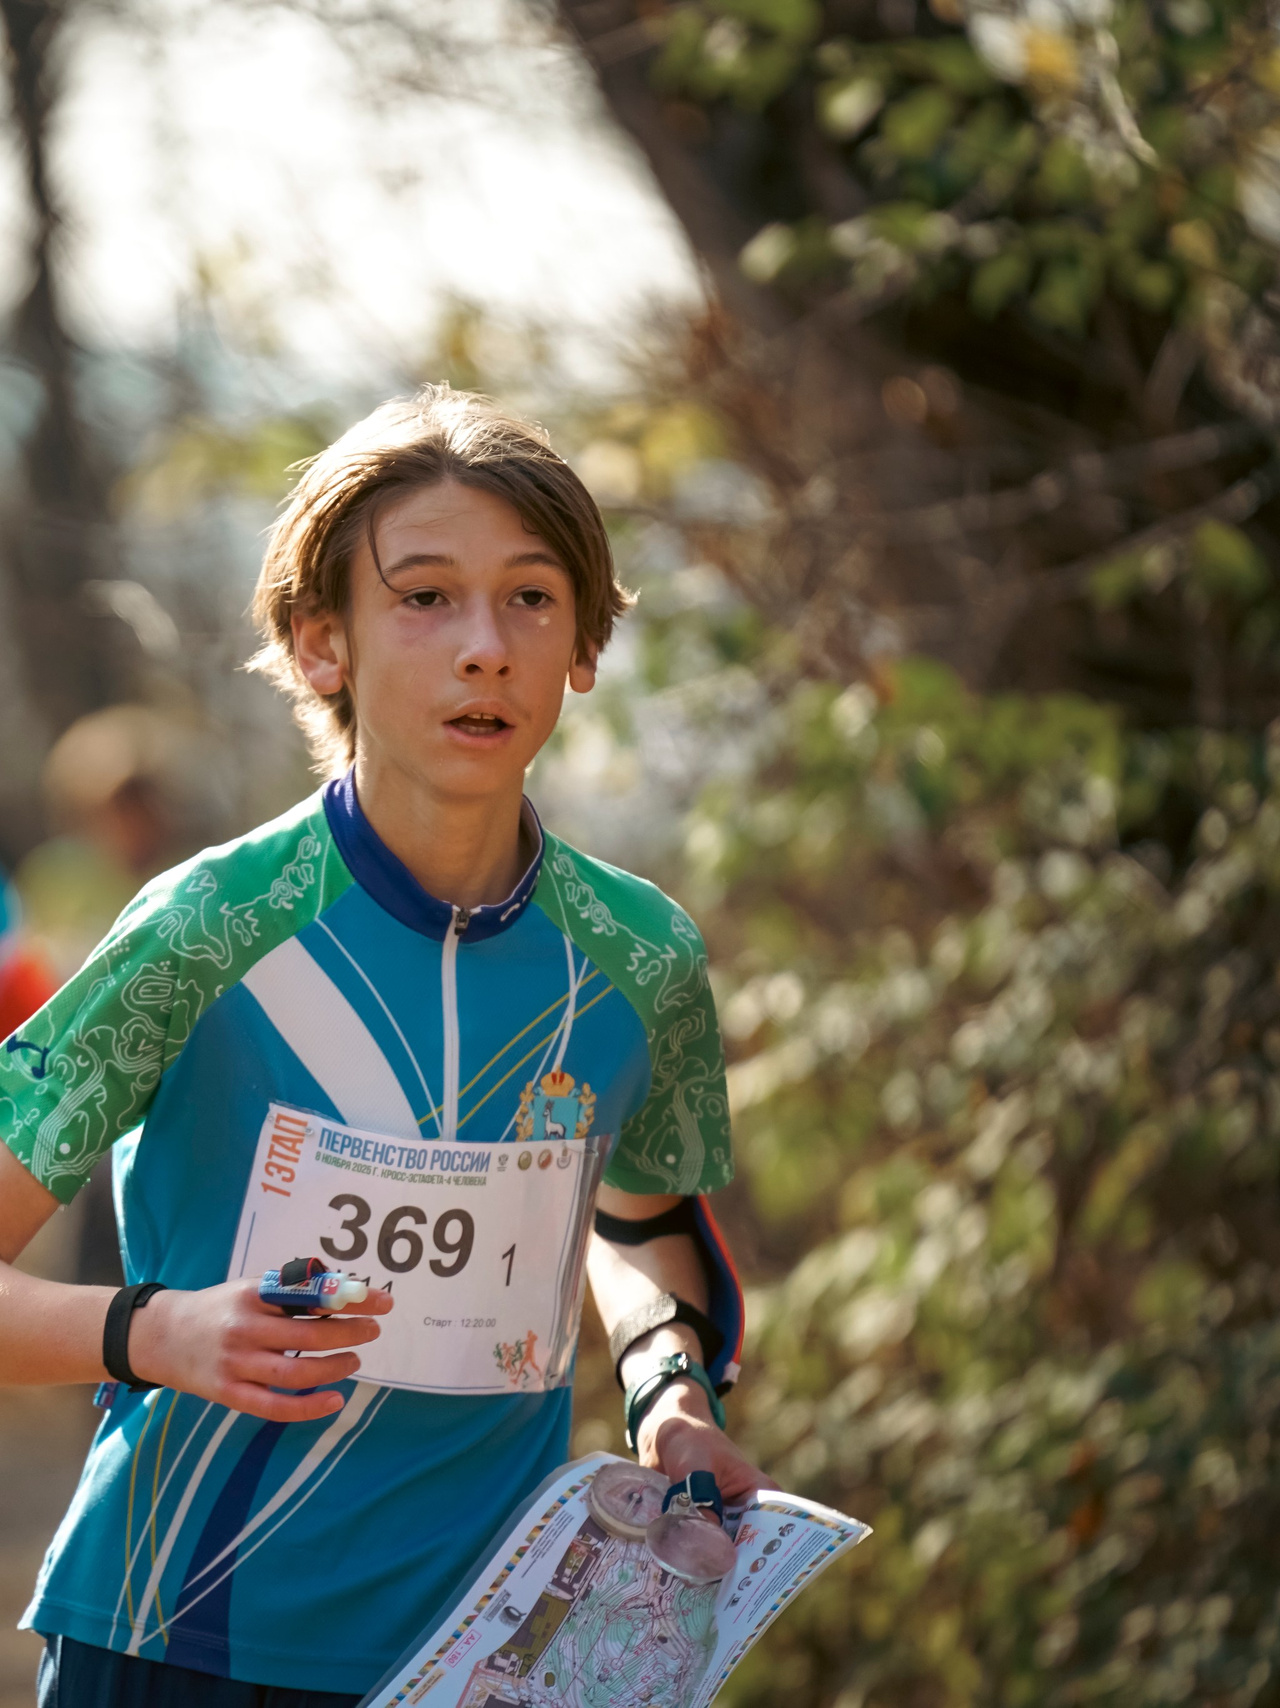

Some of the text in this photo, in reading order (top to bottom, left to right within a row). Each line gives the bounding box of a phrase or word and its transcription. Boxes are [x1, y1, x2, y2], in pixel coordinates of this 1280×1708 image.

[261, 1113, 309, 1197] 1 ЭТАП
[315, 1150, 322, 1161] 8
[321, 1153, 352, 1171] НОЯБРЯ
[452, 1175, 487, 1187] ЧЕЛОВЕКА
[318, 1127, 492, 1173] ПЕРВЕНСТВО РОССИИ
[319, 1193, 475, 1278] 369
[501, 1243, 516, 1287] 1
[423, 1316, 453, 1328] Старт
